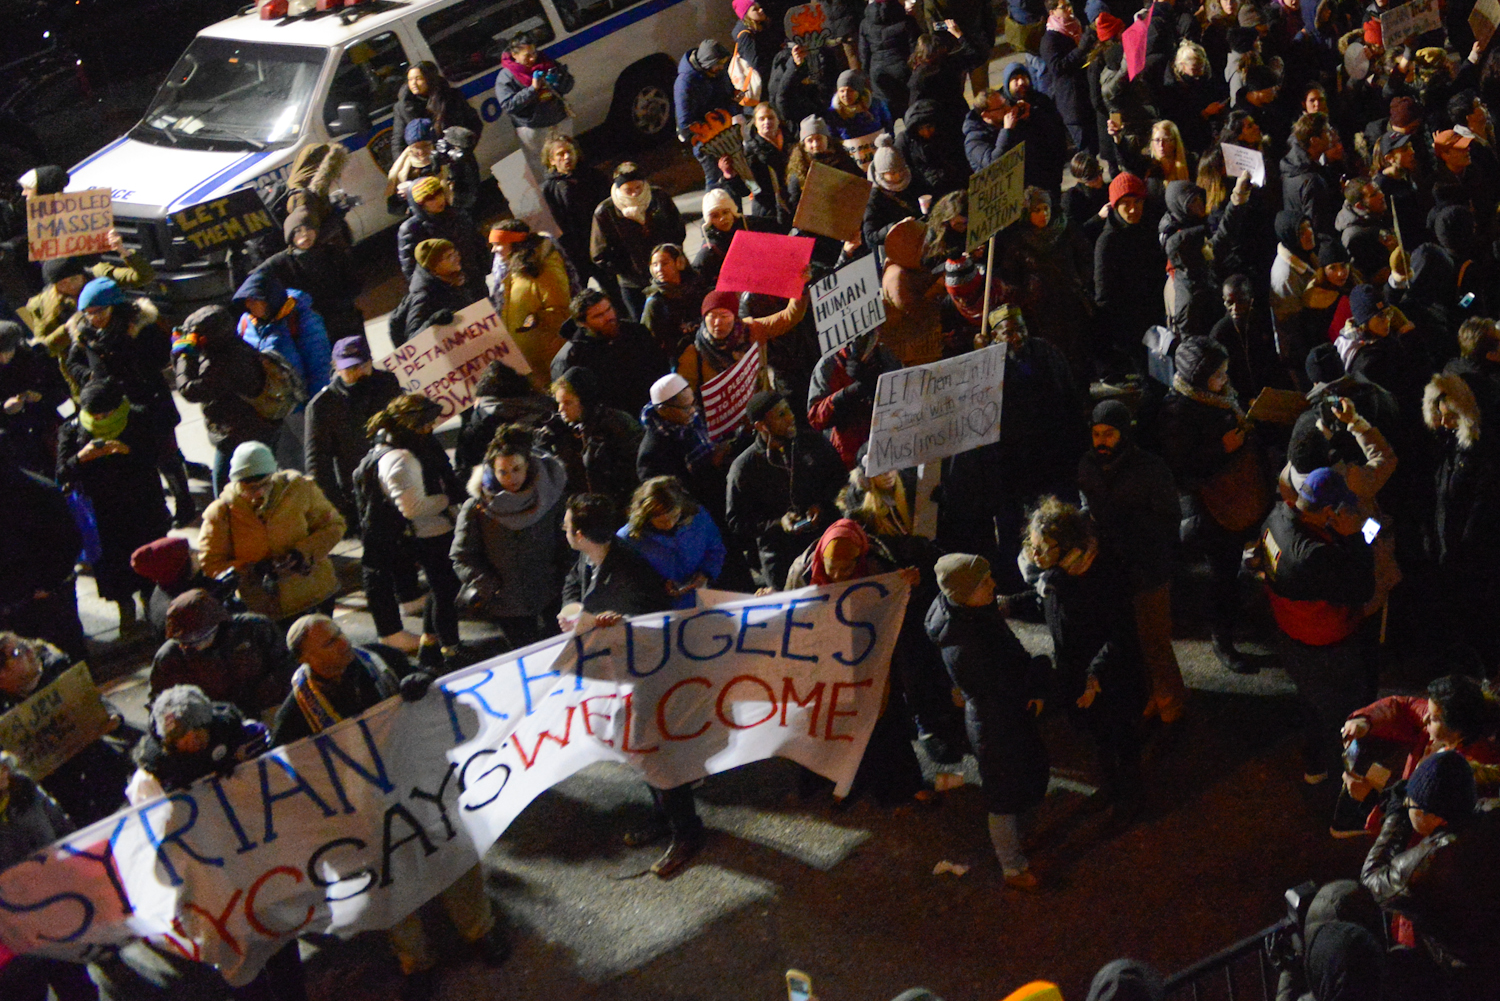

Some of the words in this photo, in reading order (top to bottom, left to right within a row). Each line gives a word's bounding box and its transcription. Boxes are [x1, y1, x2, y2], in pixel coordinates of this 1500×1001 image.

[30, 195, 111, 220] HUDDLED
[978, 171, 1013, 211] BUILT
[36, 212, 110, 239] MASSES
[174, 198, 229, 231] LET
[187, 217, 246, 249] THEM
[243, 210, 272, 233] IN
[969, 200, 1018, 246] NATION
[815, 273, 838, 298] NO
[816, 277, 867, 322] HUMAN
[403, 313, 499, 377] DETAINMENT
[821, 297, 887, 354] ILLEGAL
[383, 344, 417, 372] END
[423, 341, 510, 397] EPORTATION
[400, 379, 421, 393] ND
[876, 371, 914, 408] LET
[919, 369, 952, 396] Them
[718, 400, 729, 412] TO
[874, 409, 890, 434] I
[511, 674, 874, 771] WELCOME
[0, 719, 396, 943] SYRIAN
[441, 580, 889, 745] REFUGEES
